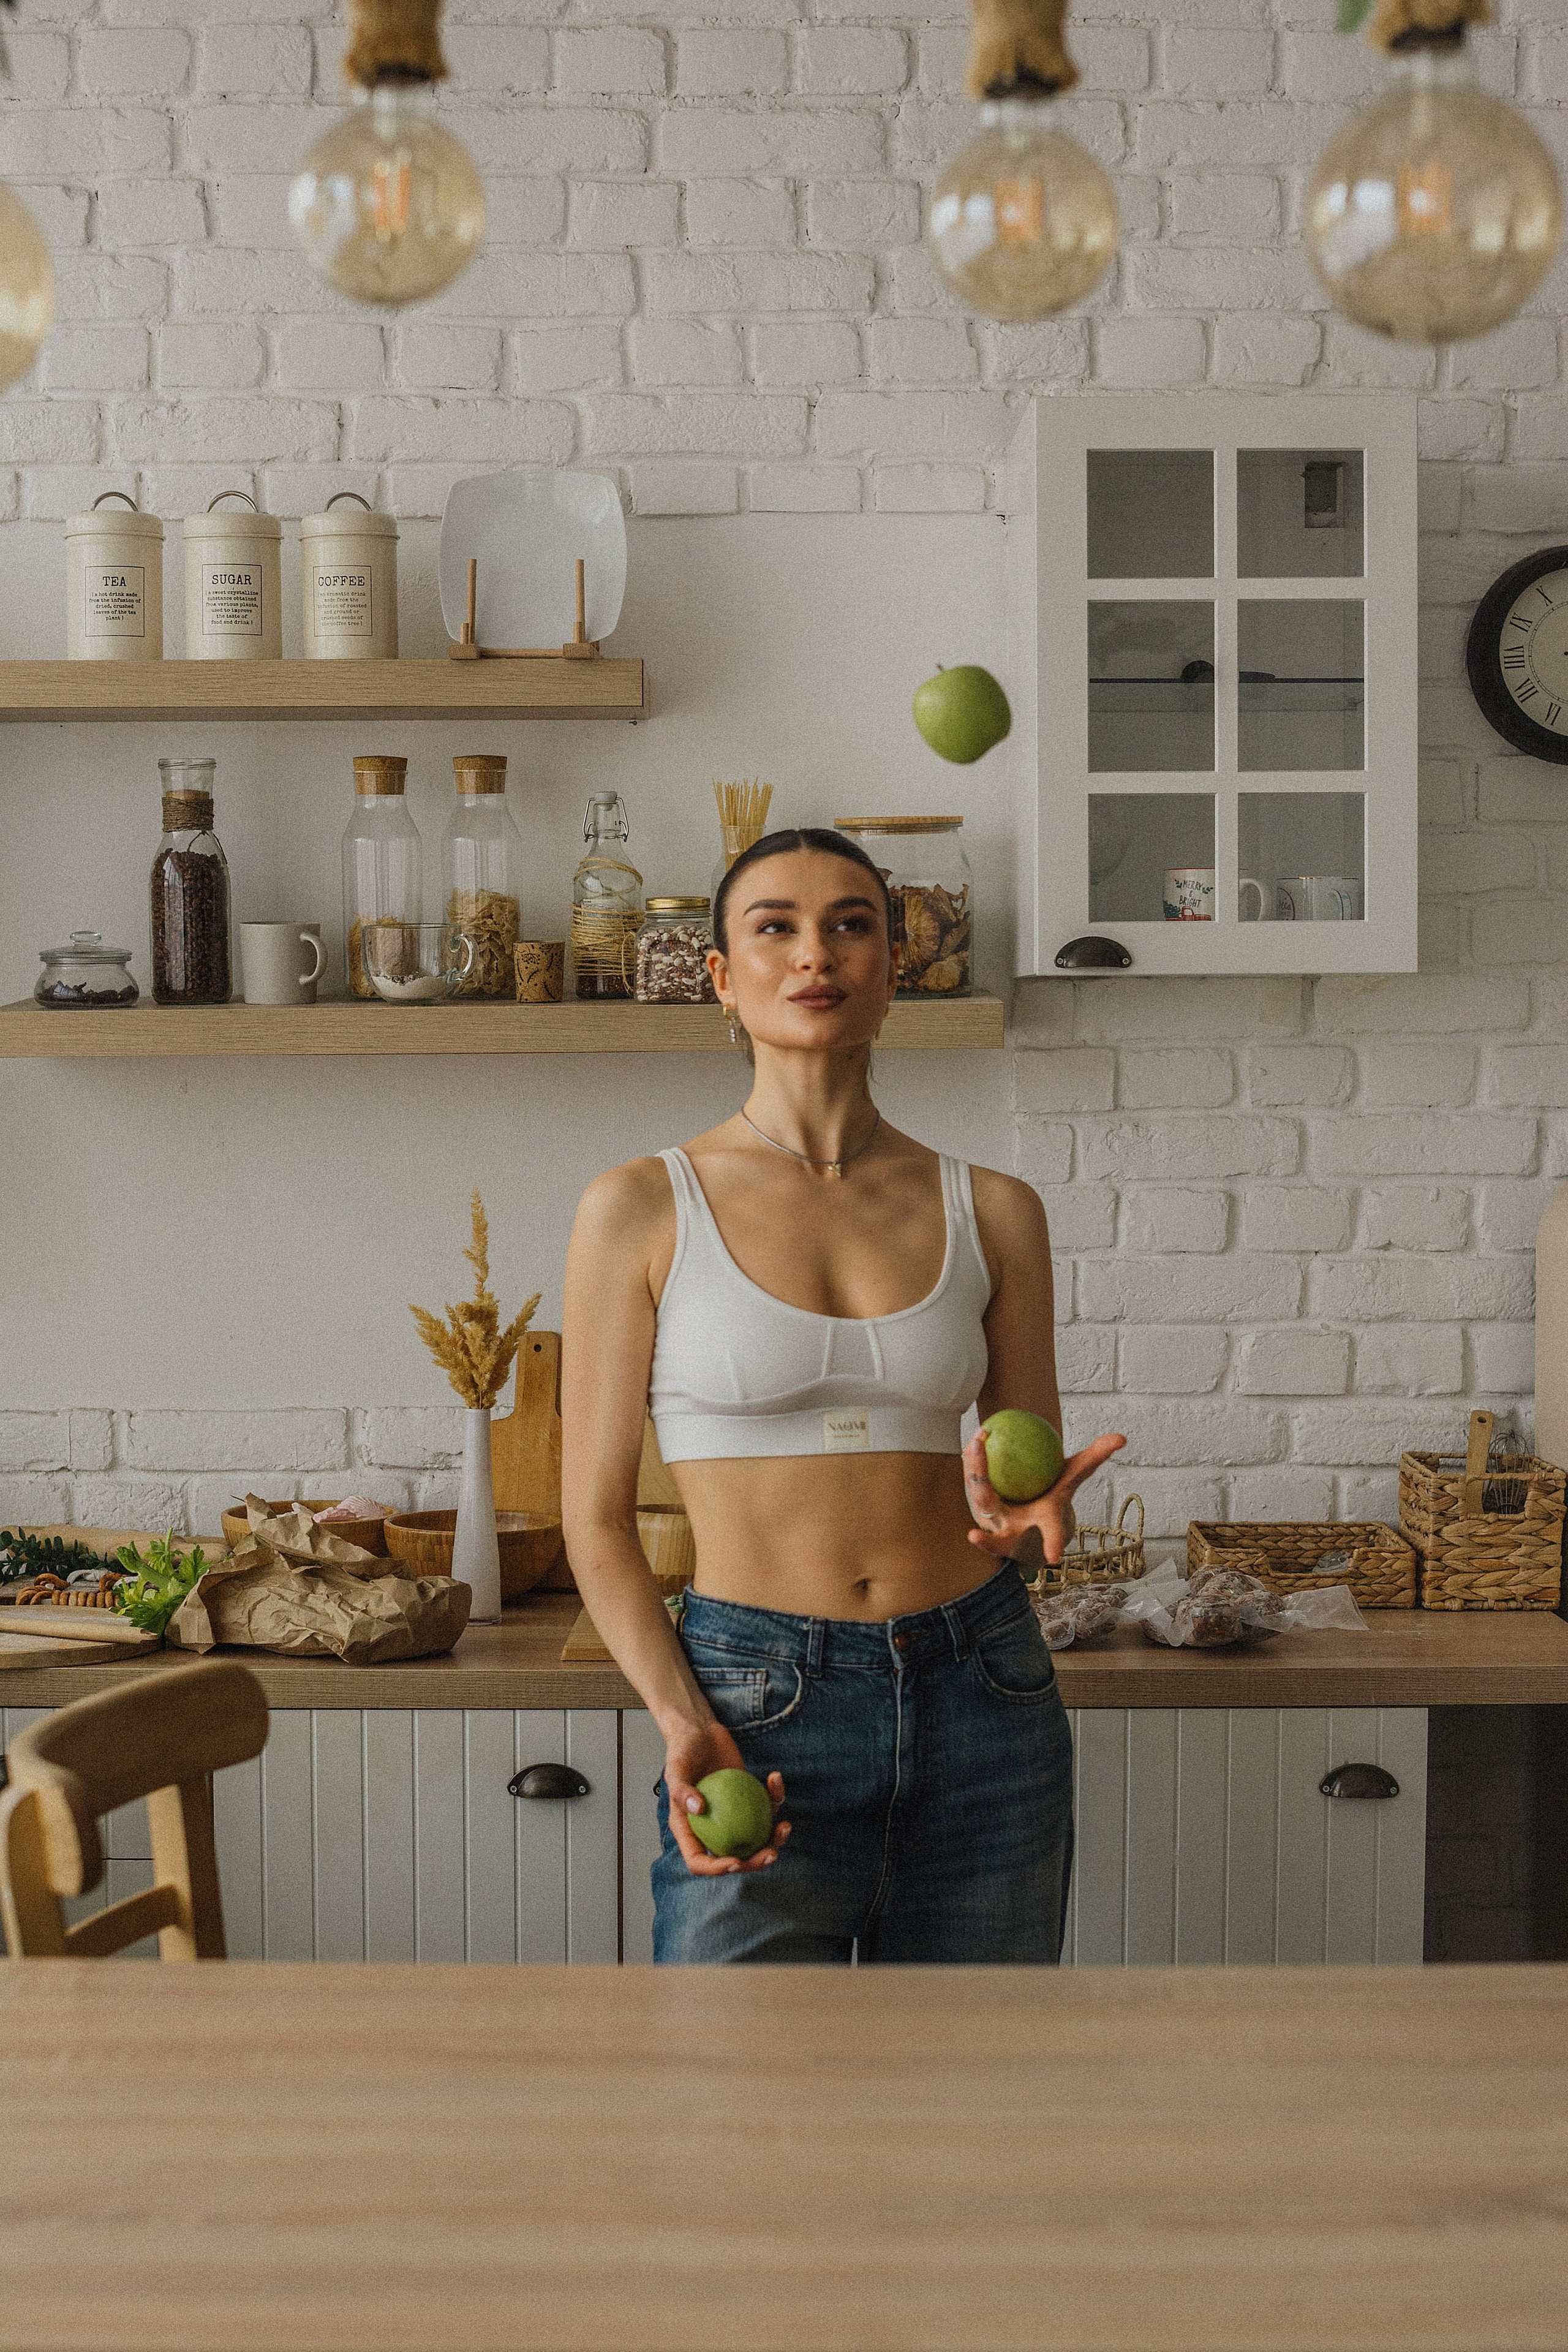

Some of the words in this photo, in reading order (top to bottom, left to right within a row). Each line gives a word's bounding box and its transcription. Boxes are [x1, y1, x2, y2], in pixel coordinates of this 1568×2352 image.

[103, 577, 127, 586] TEA
[212, 574, 252, 585] SUGAR
[318, 576, 365, 586] COFFEE
[1536, 585, 1553, 607] X
[1509, 612, 1532, 633] IX
[1504, 645, 1526, 669] VIII
[1514, 677, 1539, 703] VII
[1545, 702, 1562, 727] VI
[1183, 880, 1203, 890] MERRY
[1179, 895, 1202, 907] BRIGHT
